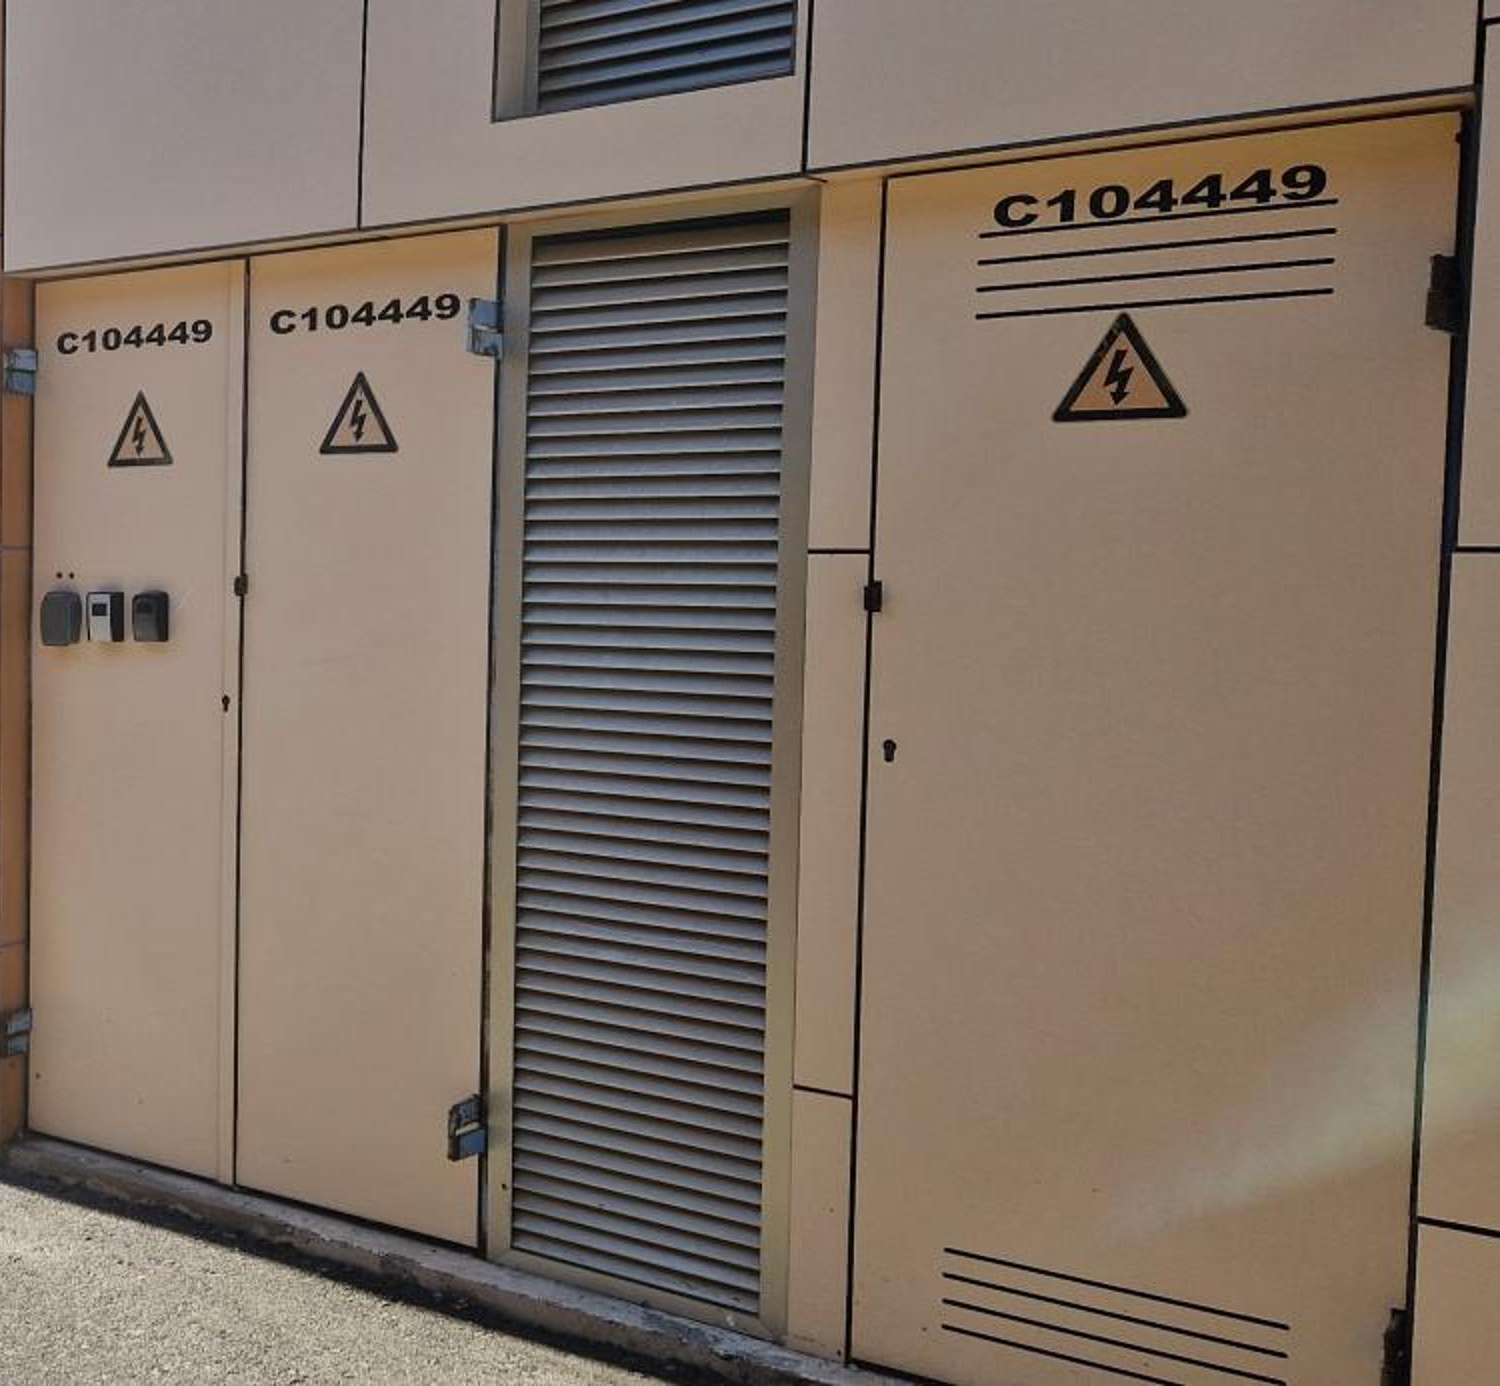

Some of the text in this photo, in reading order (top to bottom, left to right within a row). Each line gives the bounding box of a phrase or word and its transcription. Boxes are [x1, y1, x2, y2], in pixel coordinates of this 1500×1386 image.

[993, 164, 1327, 228] C104449
[269, 293, 461, 335] C104449
[56, 319, 213, 355] C104449
